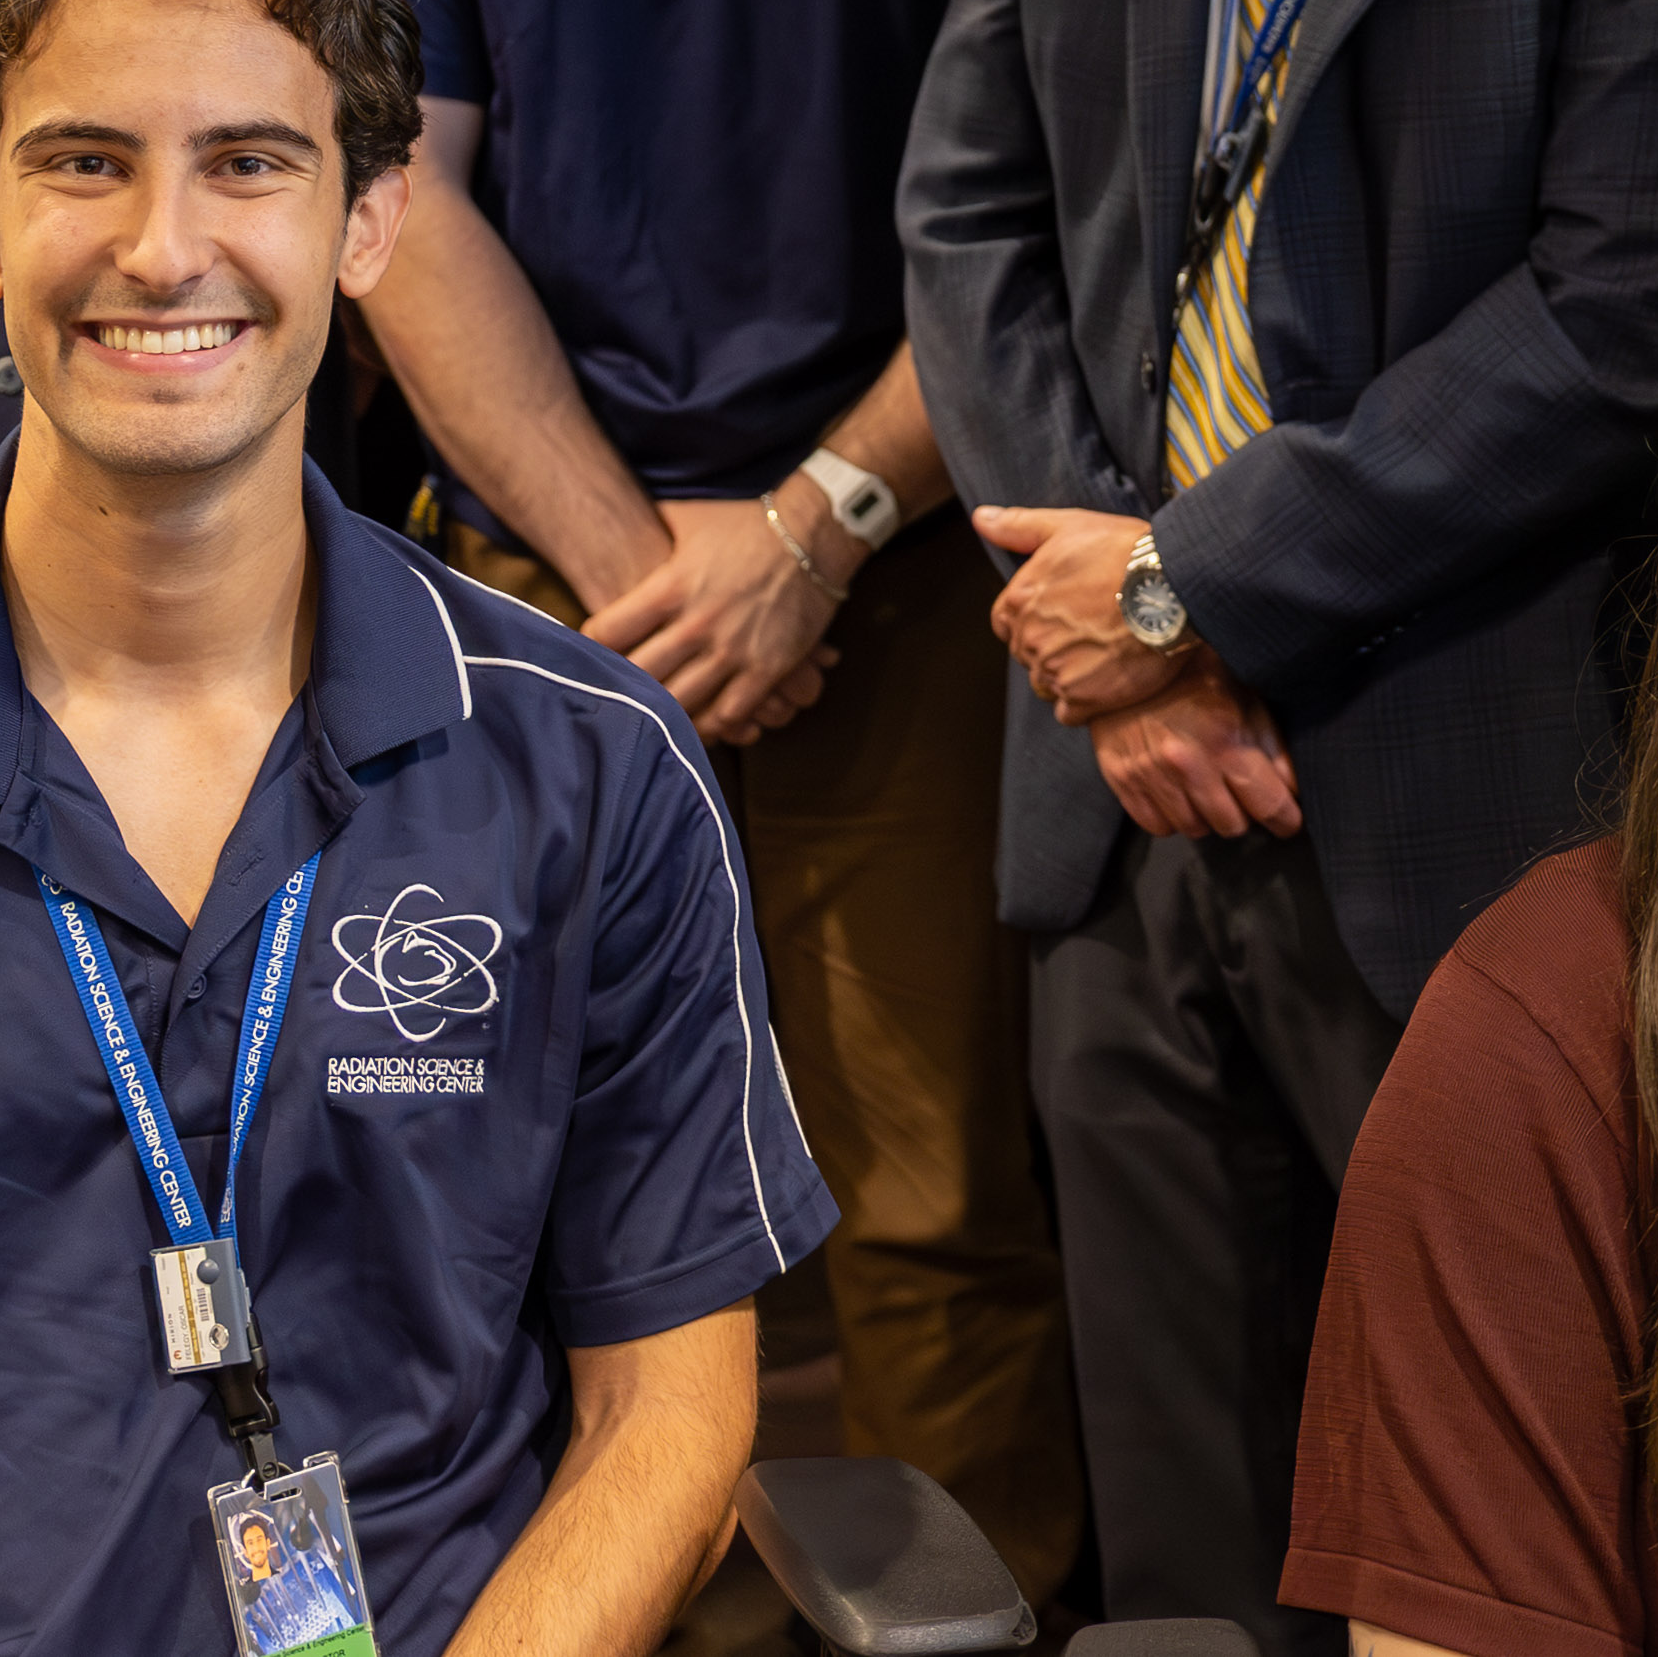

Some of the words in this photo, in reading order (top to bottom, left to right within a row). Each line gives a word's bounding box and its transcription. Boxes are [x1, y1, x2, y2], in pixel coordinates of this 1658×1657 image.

[60, 901, 101, 983] RADIATION
[261, 897, 298, 1004] ENGINEERING
[90, 982, 125, 1048] SCIENCE
[257, 1004, 274, 1019] &
[113, 1048, 130, 1065] &
[244, 1019, 270, 1087] SCIENCE
[328, 1057, 415, 1076] RADIATION
[416, 1058, 474, 1077] SCIENCE
[474, 1059, 485, 1077] &
[327, 1075, 435, 1094] ENGINEERING
[436, 1076, 484, 1094] CENTER
[119, 1063, 170, 1169] ENGINEERING
[159, 1170, 192, 1229] CENTER
[178, 1305, 188, 1330] OSCAR
[313, 1632, 346, 1649] Engineering
